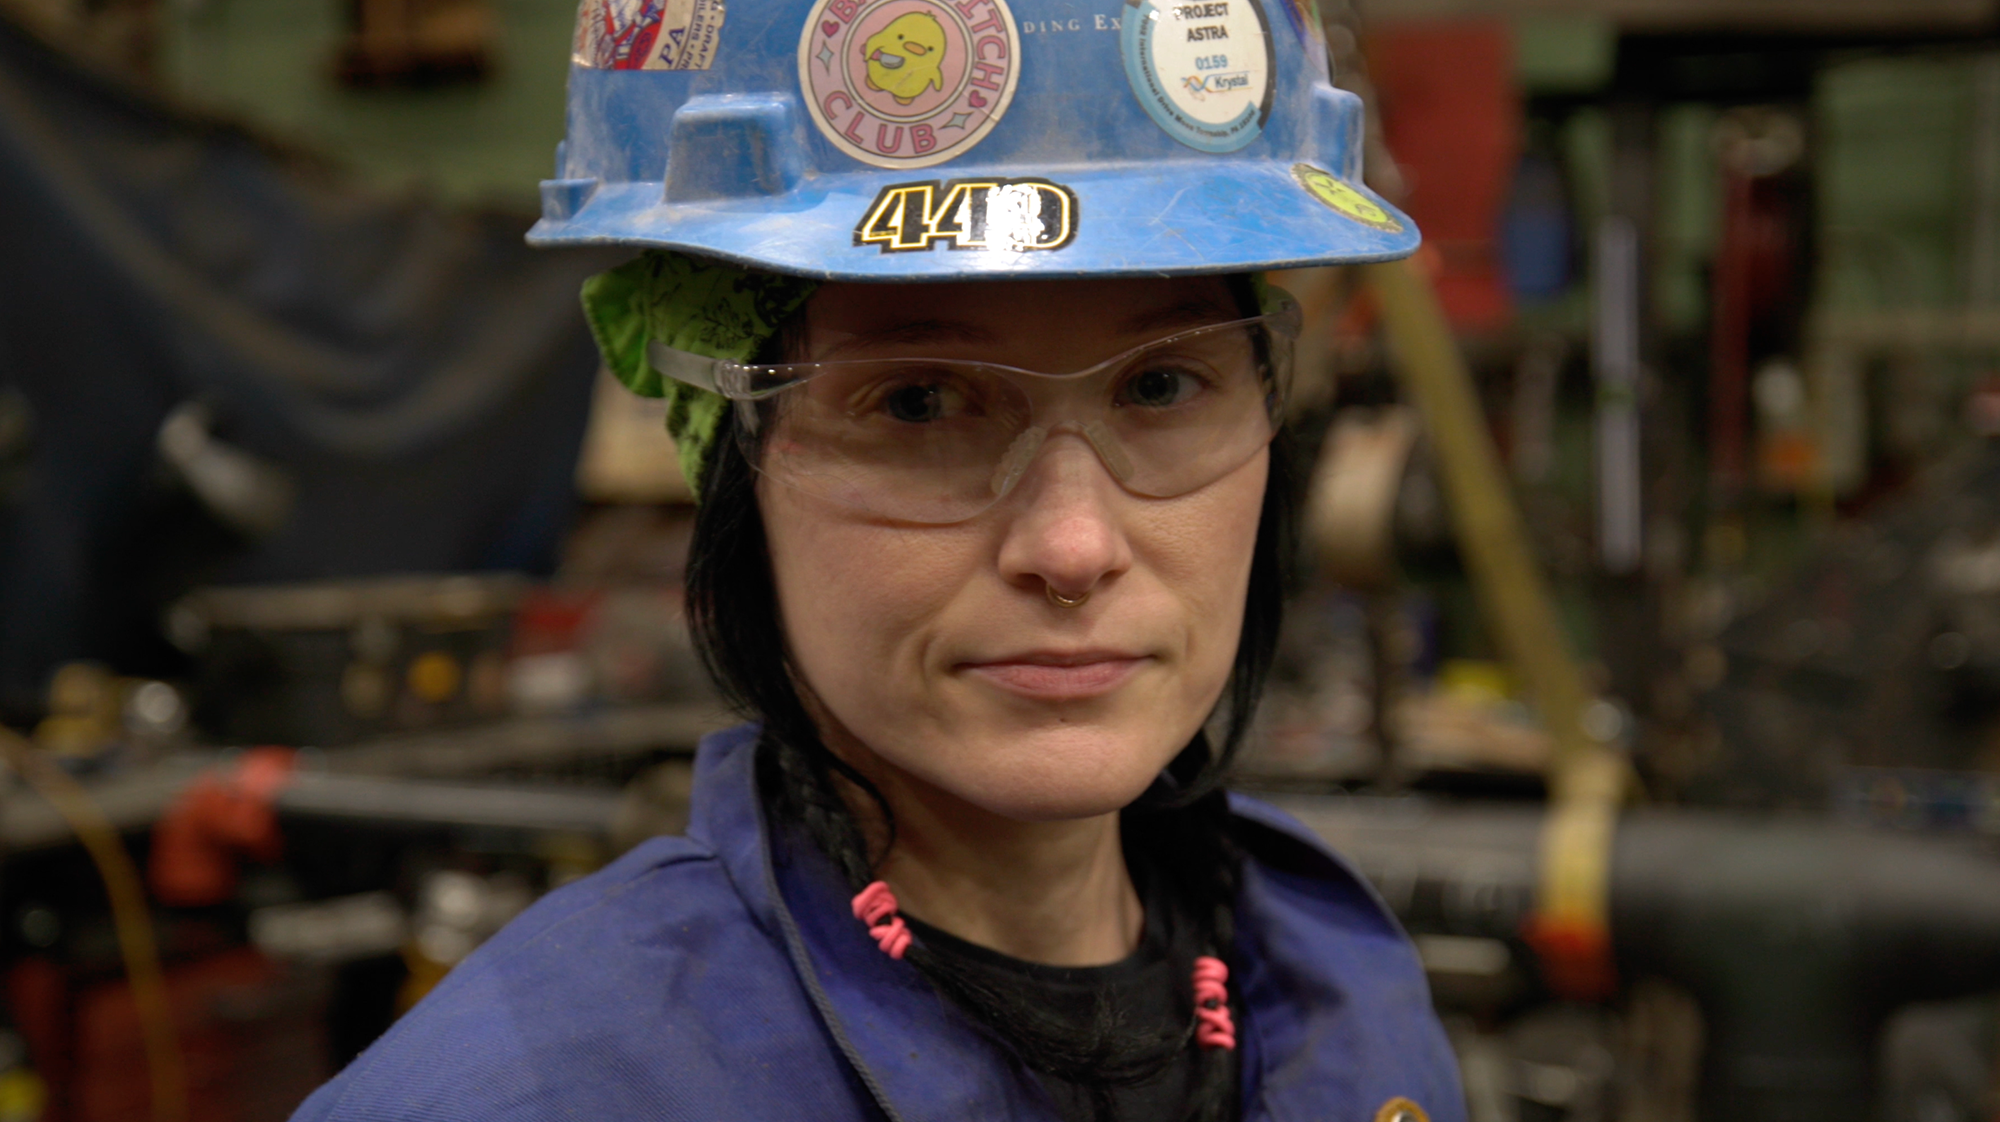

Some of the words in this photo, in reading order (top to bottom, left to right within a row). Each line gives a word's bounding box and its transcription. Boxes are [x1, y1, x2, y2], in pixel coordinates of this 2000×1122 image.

[1172, 3, 1228, 20] PROJECT
[658, 26, 686, 67] PA
[950, 0, 1006, 91] ITCH
[1187, 25, 1229, 42] ASTRA
[1195, 54, 1228, 70] 0159
[1214, 74, 1248, 91] Krystal
[823, 91, 937, 154] CLUB
[857, 180, 1074, 250] 440
